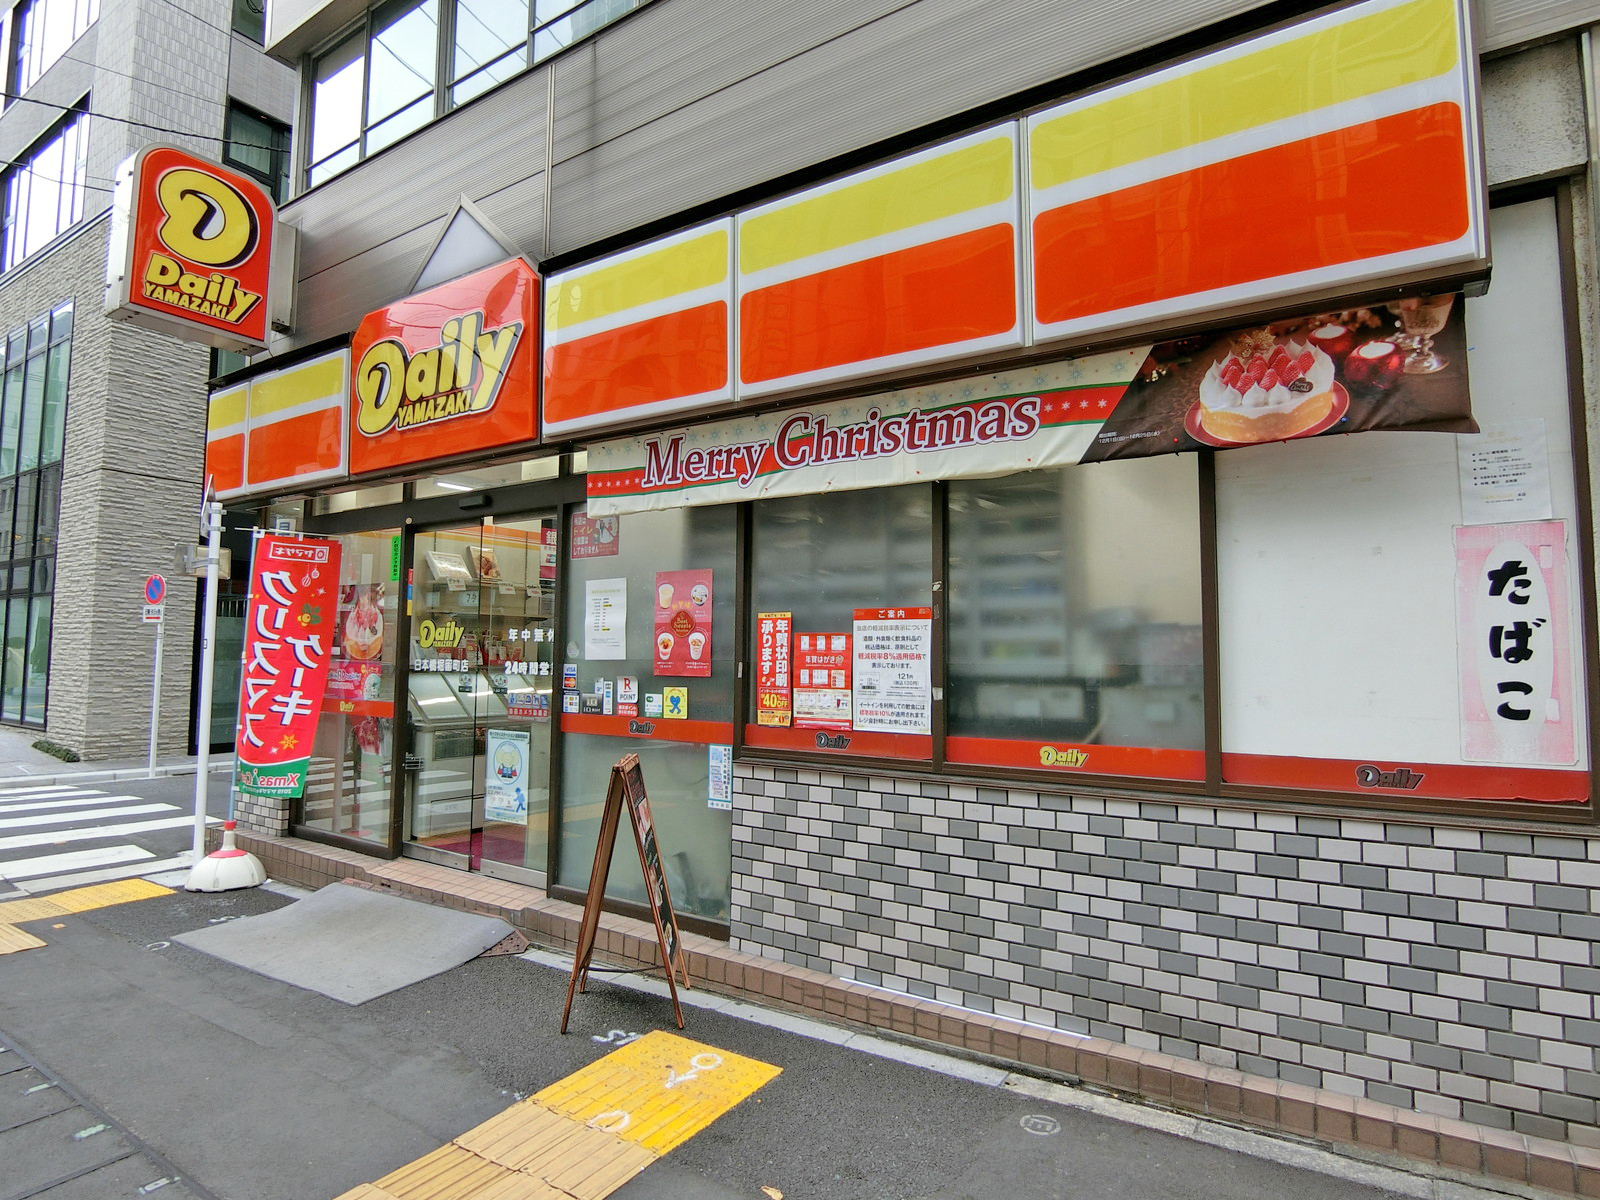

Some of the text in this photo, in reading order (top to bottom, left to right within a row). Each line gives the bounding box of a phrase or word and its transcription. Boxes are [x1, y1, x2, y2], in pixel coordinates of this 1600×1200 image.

[145, 253, 262, 323] Daily
[145, 282, 230, 319] YAMAZAKI
[358, 311, 522, 434] Daily
[398, 390, 472, 428] YAMAZAKI
[643, 397, 1040, 488] Merry Christmas
[573, 526, 593, 536] トイレ
[878, 609, 905, 619] ご案内
[419, 619, 465, 648] Daily
[761, 619, 774, 675] 承ります
[1487, 560, 1547, 721] たばこ
[775, 619, 788, 687] 年賀状印刷
[805, 655, 836, 664] 年賀はがき
[504, 660, 554, 676] 24時間営
[620, 693, 636, 701] POINT
[623, 677, 632, 690] R
[815, 732, 851, 750] Daily
[1040, 746, 1089, 767] Daily
[1356, 765, 1425, 790] Daily
